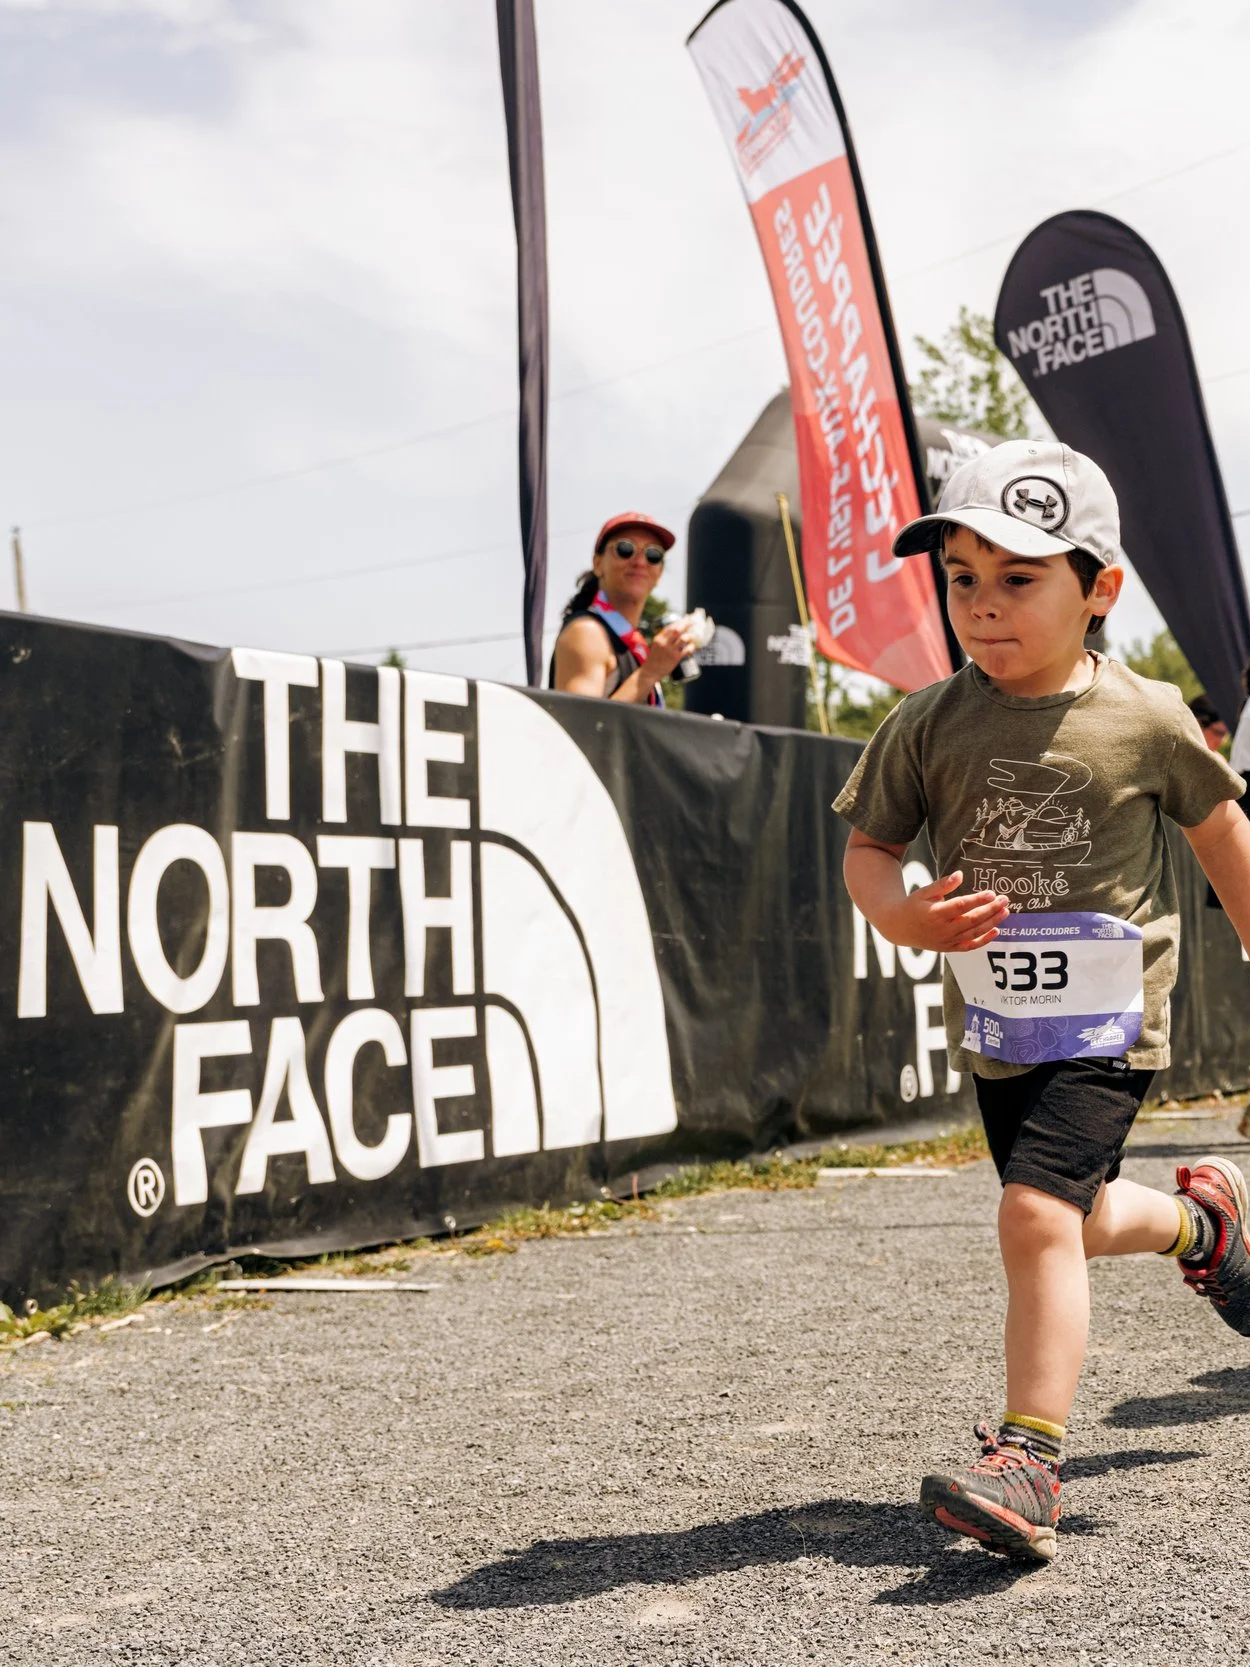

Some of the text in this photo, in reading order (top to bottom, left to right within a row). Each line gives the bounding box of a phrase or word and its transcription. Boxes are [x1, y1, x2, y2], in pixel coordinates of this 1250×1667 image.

[1039, 272, 1096, 315] THE
[1007, 299, 1100, 359] NORTH
[1036, 327, 1104, 376] FACE
[231, 647, 472, 830] THE
[972, 867, 1070, 896] Hooké
[1027, 896, 1053, 910] Club
[17, 821, 476, 1019] NORTH
[986, 950, 1069, 992] 533
[1029, 994, 1062, 1005] MORIN
[171, 1005, 485, 1207] FACE
